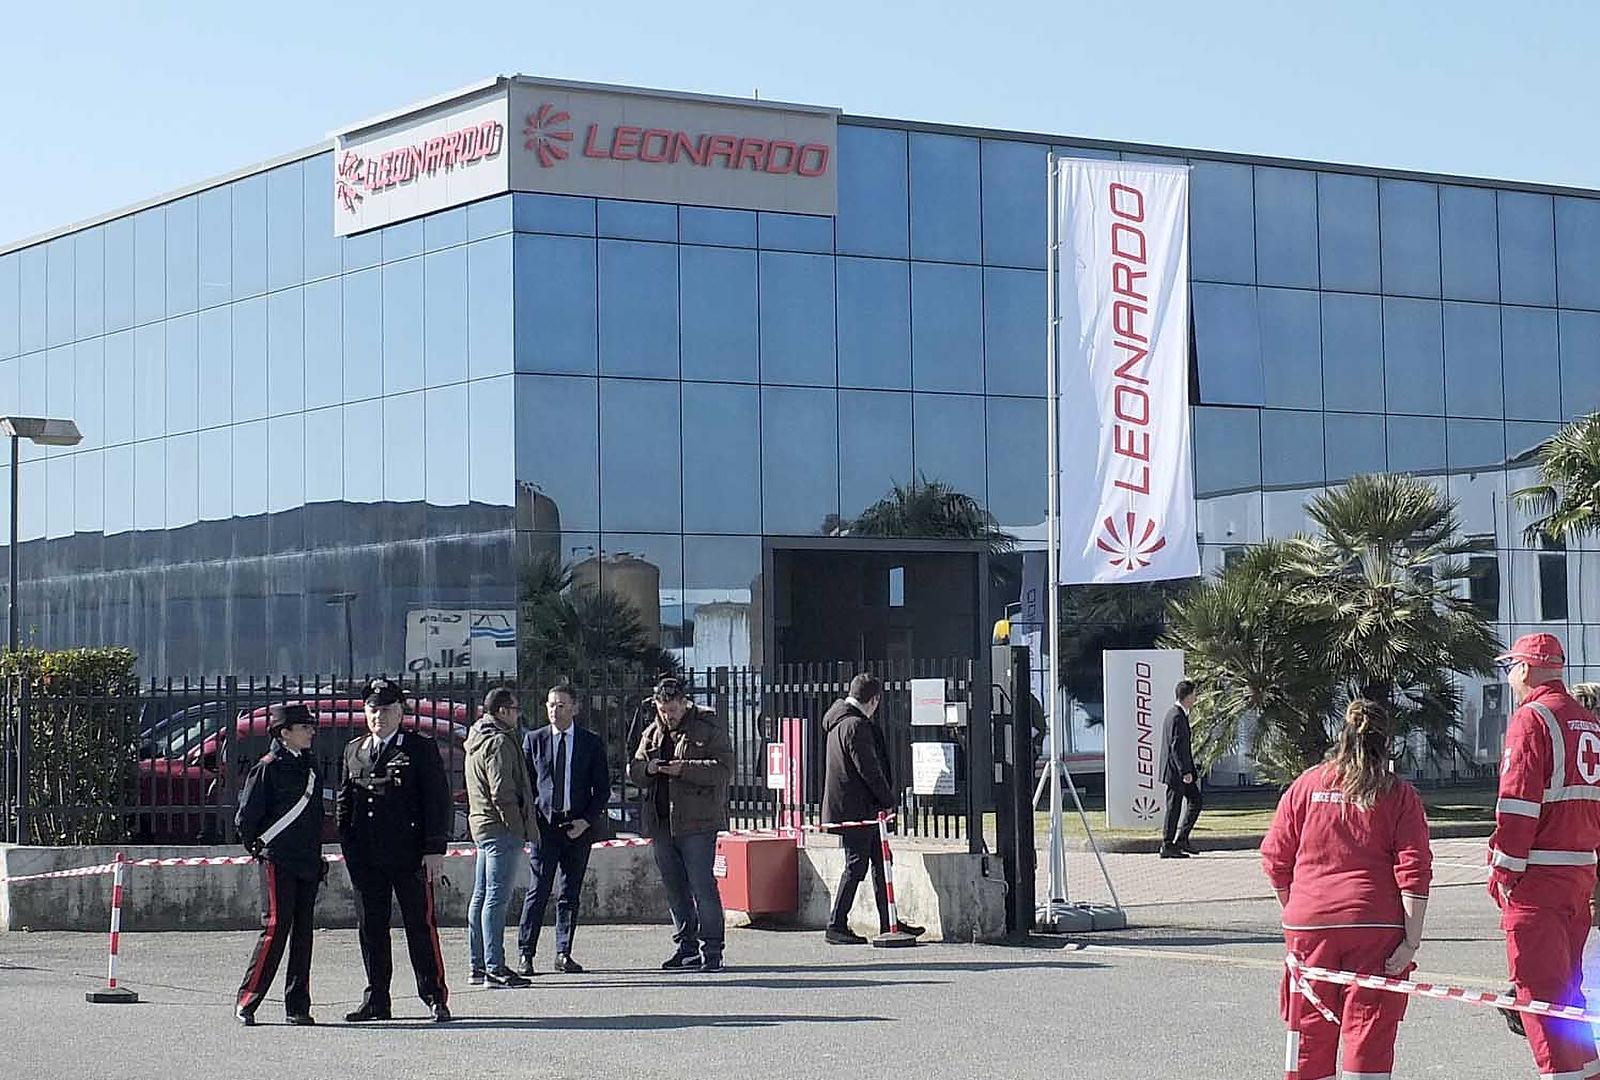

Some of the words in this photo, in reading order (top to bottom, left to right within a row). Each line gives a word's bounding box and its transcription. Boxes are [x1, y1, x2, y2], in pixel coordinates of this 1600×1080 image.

[362, 121, 500, 190] LEONARDO
[583, 122, 829, 178] LEONARDO
[1110, 182, 1150, 495] LEONARDO
[1136, 662, 1153, 790] LEONARDO
